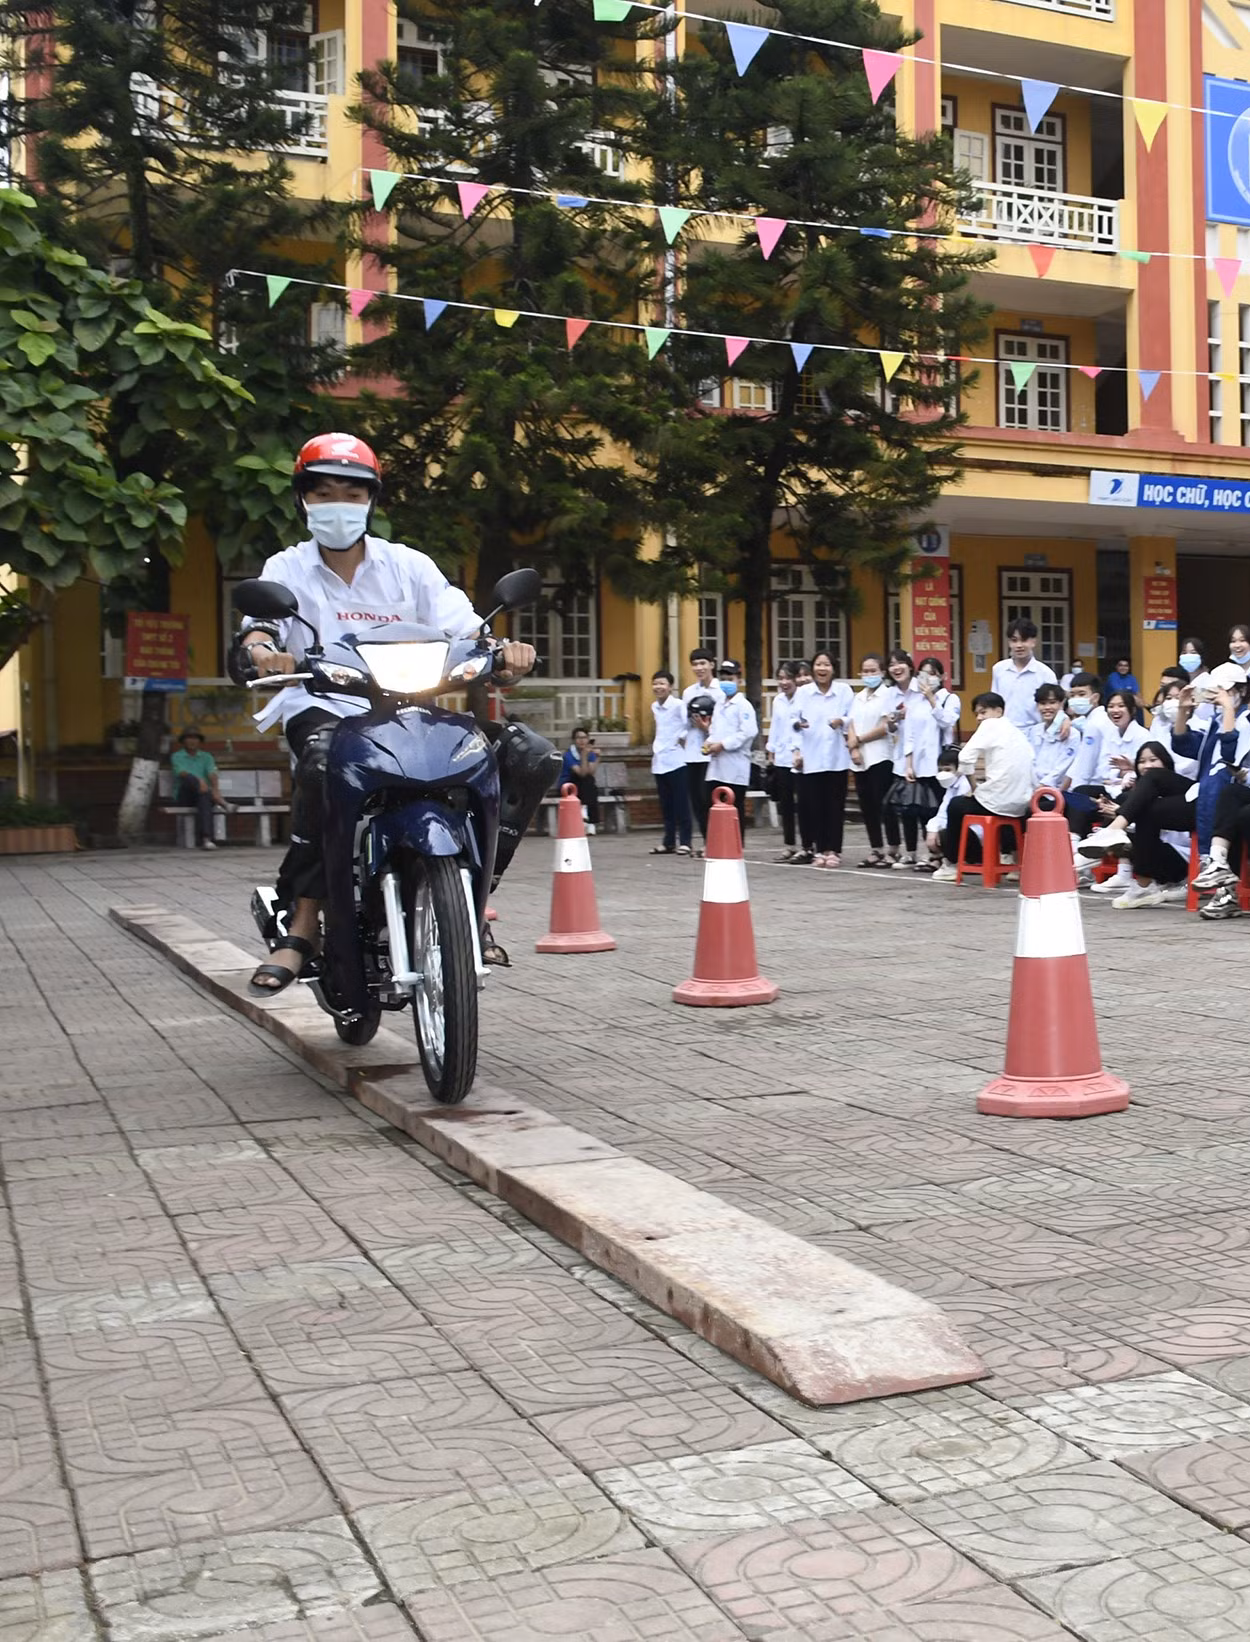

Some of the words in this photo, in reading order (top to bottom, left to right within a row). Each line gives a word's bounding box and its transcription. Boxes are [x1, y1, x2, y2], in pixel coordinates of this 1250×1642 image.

[1143, 484, 1174, 505] HỌC
[1176, 484, 1210, 508] CHỮ,
[1213, 489, 1242, 509] HỌC
[336, 612, 402, 622] HONDA
[396, 706, 432, 715] HONDA
